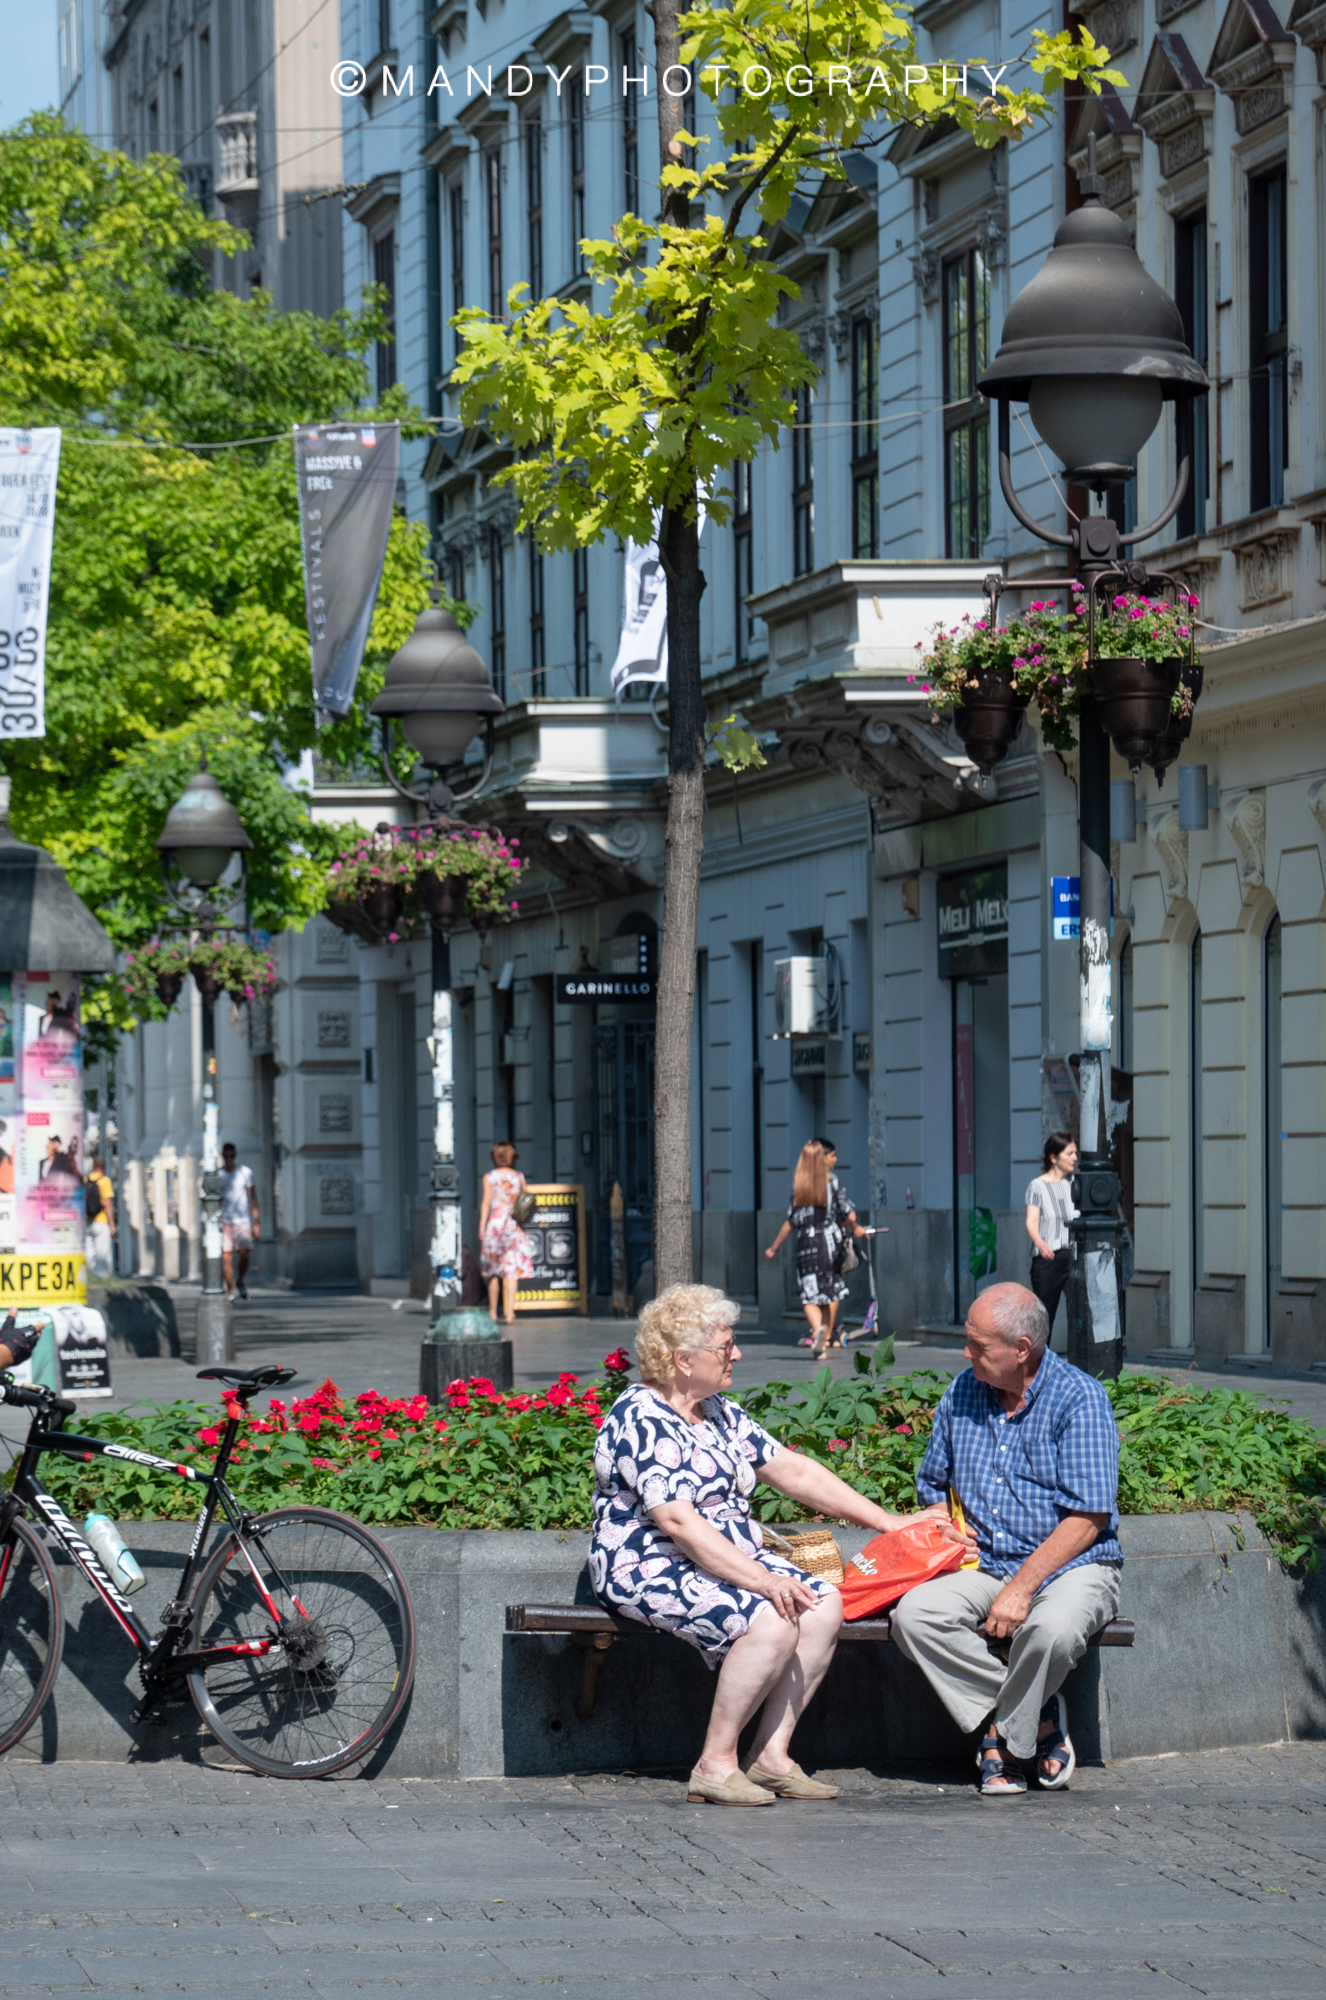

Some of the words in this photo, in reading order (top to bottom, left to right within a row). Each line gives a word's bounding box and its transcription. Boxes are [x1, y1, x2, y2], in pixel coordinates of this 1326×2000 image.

[307, 508, 327, 641] FESTIVALS
[939, 906, 971, 935] MELI
[565, 982, 650, 995] GARINELLO
[35, 1495, 133, 1613] SPECIALIZED
